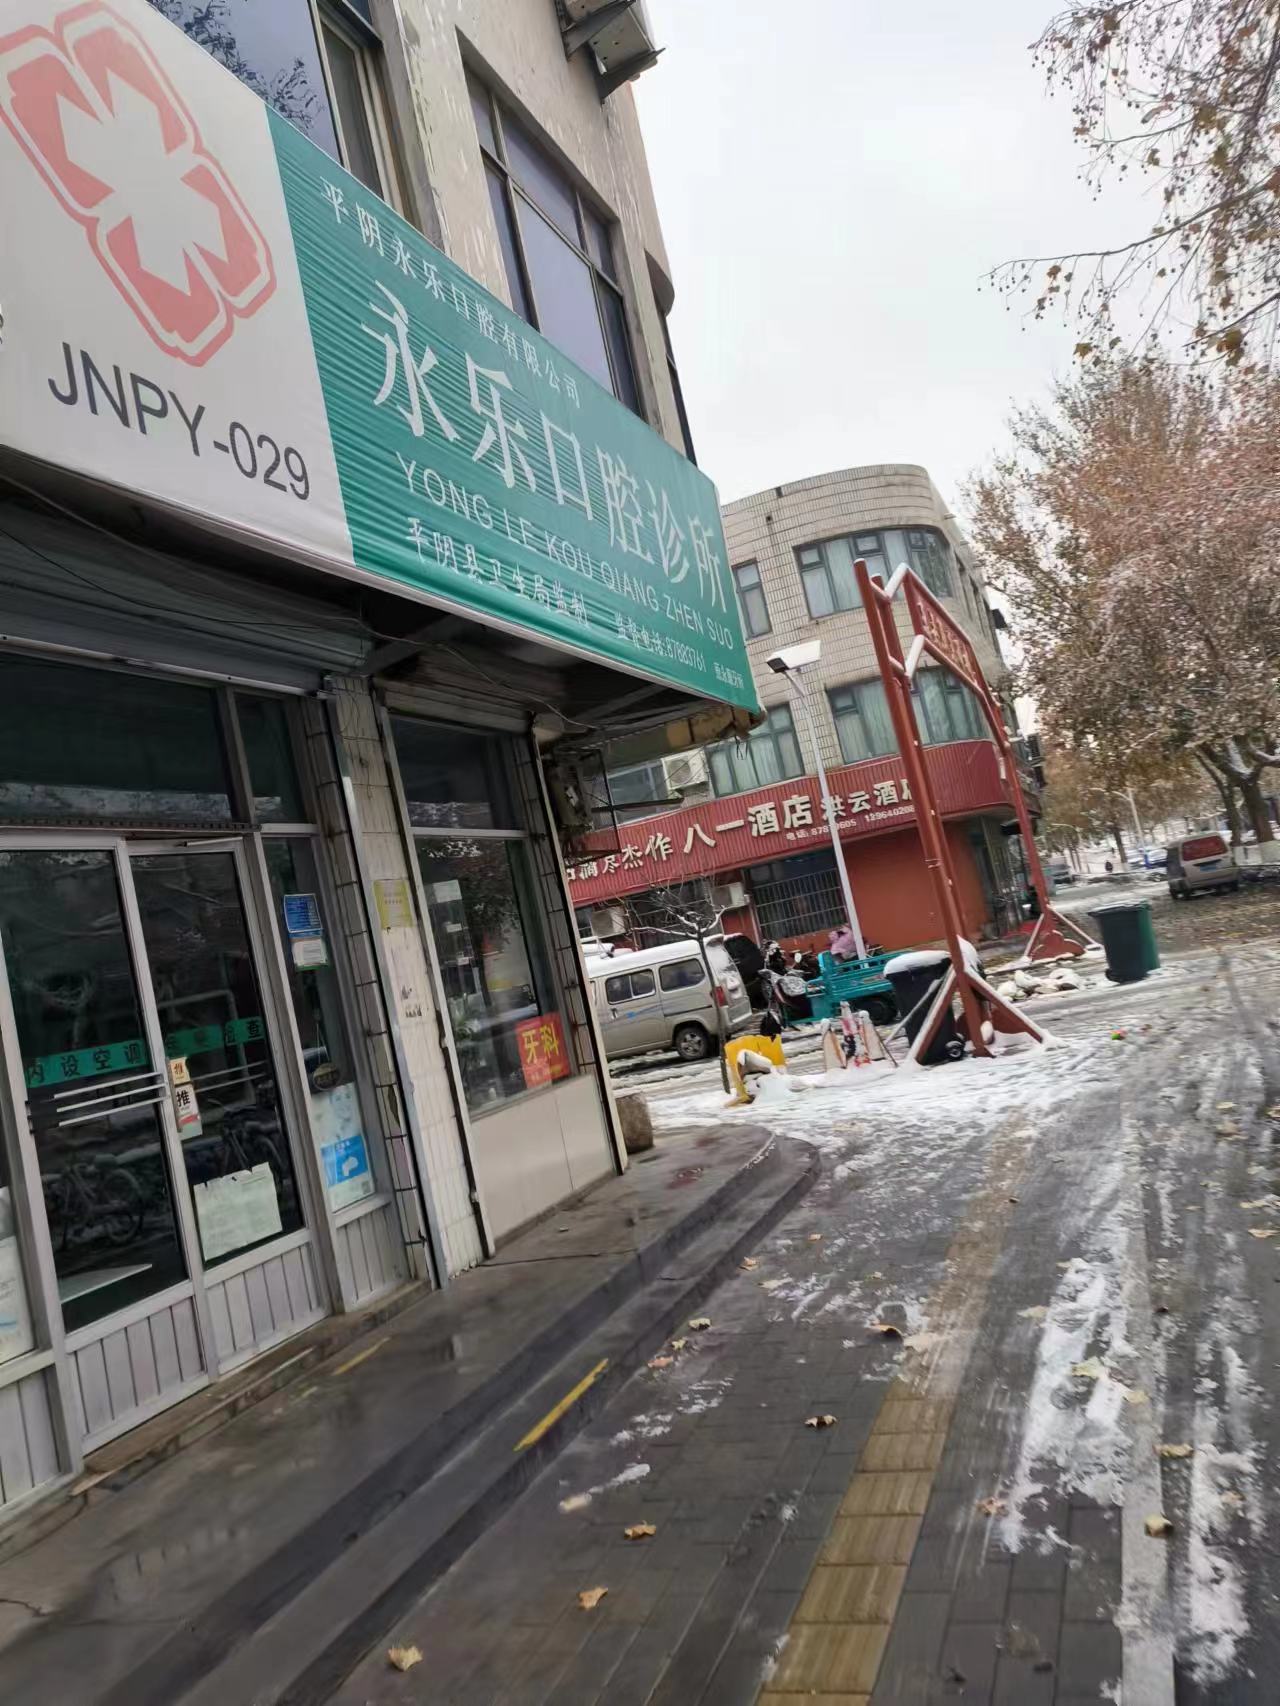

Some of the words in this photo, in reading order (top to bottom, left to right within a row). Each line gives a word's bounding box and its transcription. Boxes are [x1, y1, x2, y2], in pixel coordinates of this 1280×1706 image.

[320, 176, 581, 408] 平阴永乐口腔有限公司
[48, 341, 311, 501] JNPY-029
[360, 279, 728, 613] 永乐口腔诊所
[396, 450, 494, 530] YONG
[503, 508, 539, 553] LE
[544, 530, 593, 580] KOU
[600, 565, 660, 612] QIANG
[663, 594, 705, 636] ZHEN
[706, 616, 734, 650] SUO
[406, 517, 592, 629] 平阴县卫生局监制
[684, 794, 814, 854] 八一酒店
[27, 1042, 142, 1084] 内设空调
[176, 1089, 191, 1108] 推
[522, 1022, 560, 1064] 牙科
